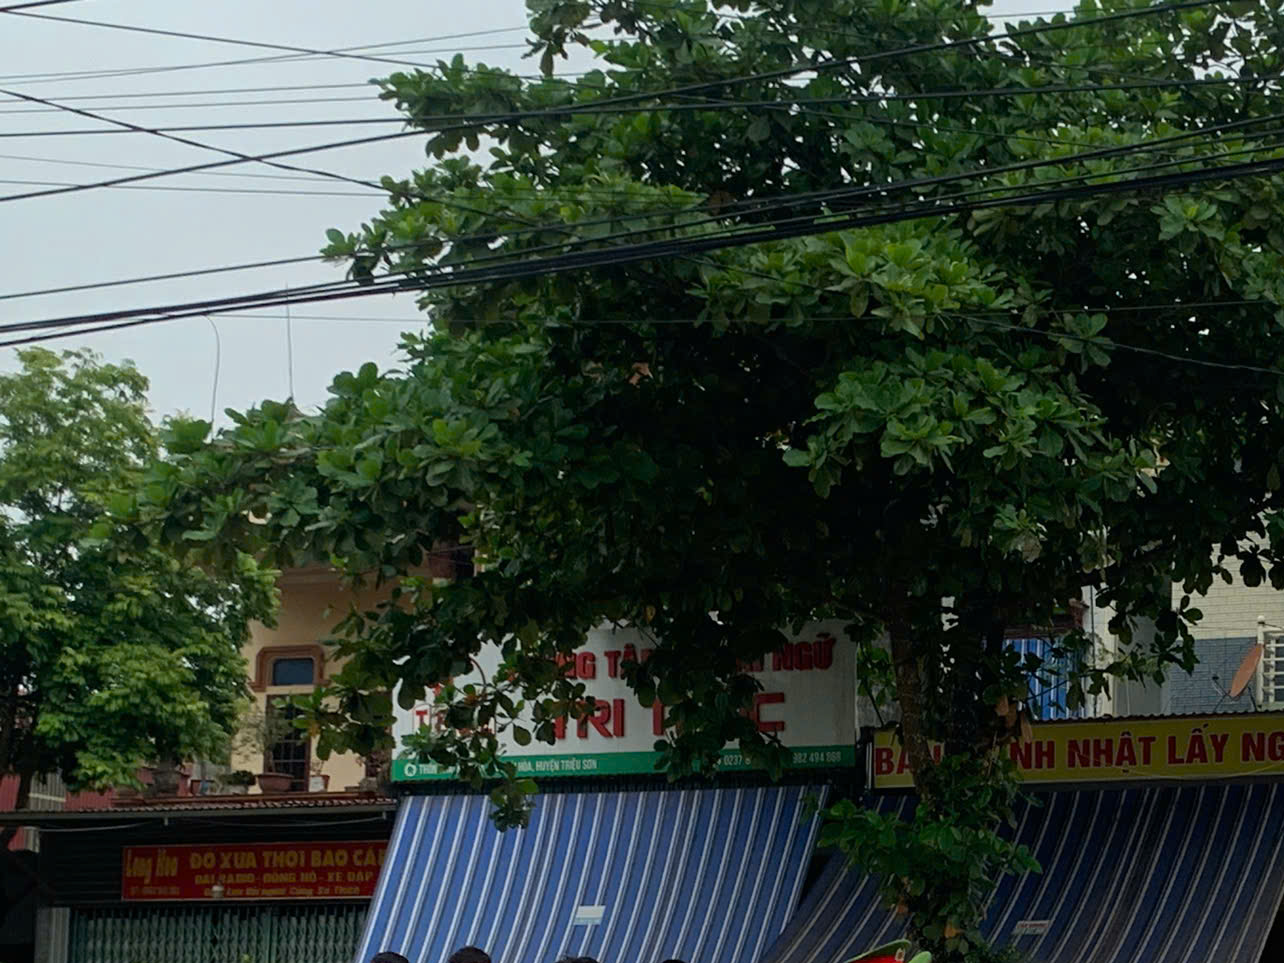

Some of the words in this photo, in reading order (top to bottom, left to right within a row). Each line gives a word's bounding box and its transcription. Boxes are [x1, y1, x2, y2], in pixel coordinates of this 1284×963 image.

[1067, 731, 1157, 773] NHẬT
[1167, 723, 1230, 765] LẤY
[311, 849, 349, 867] BAO
